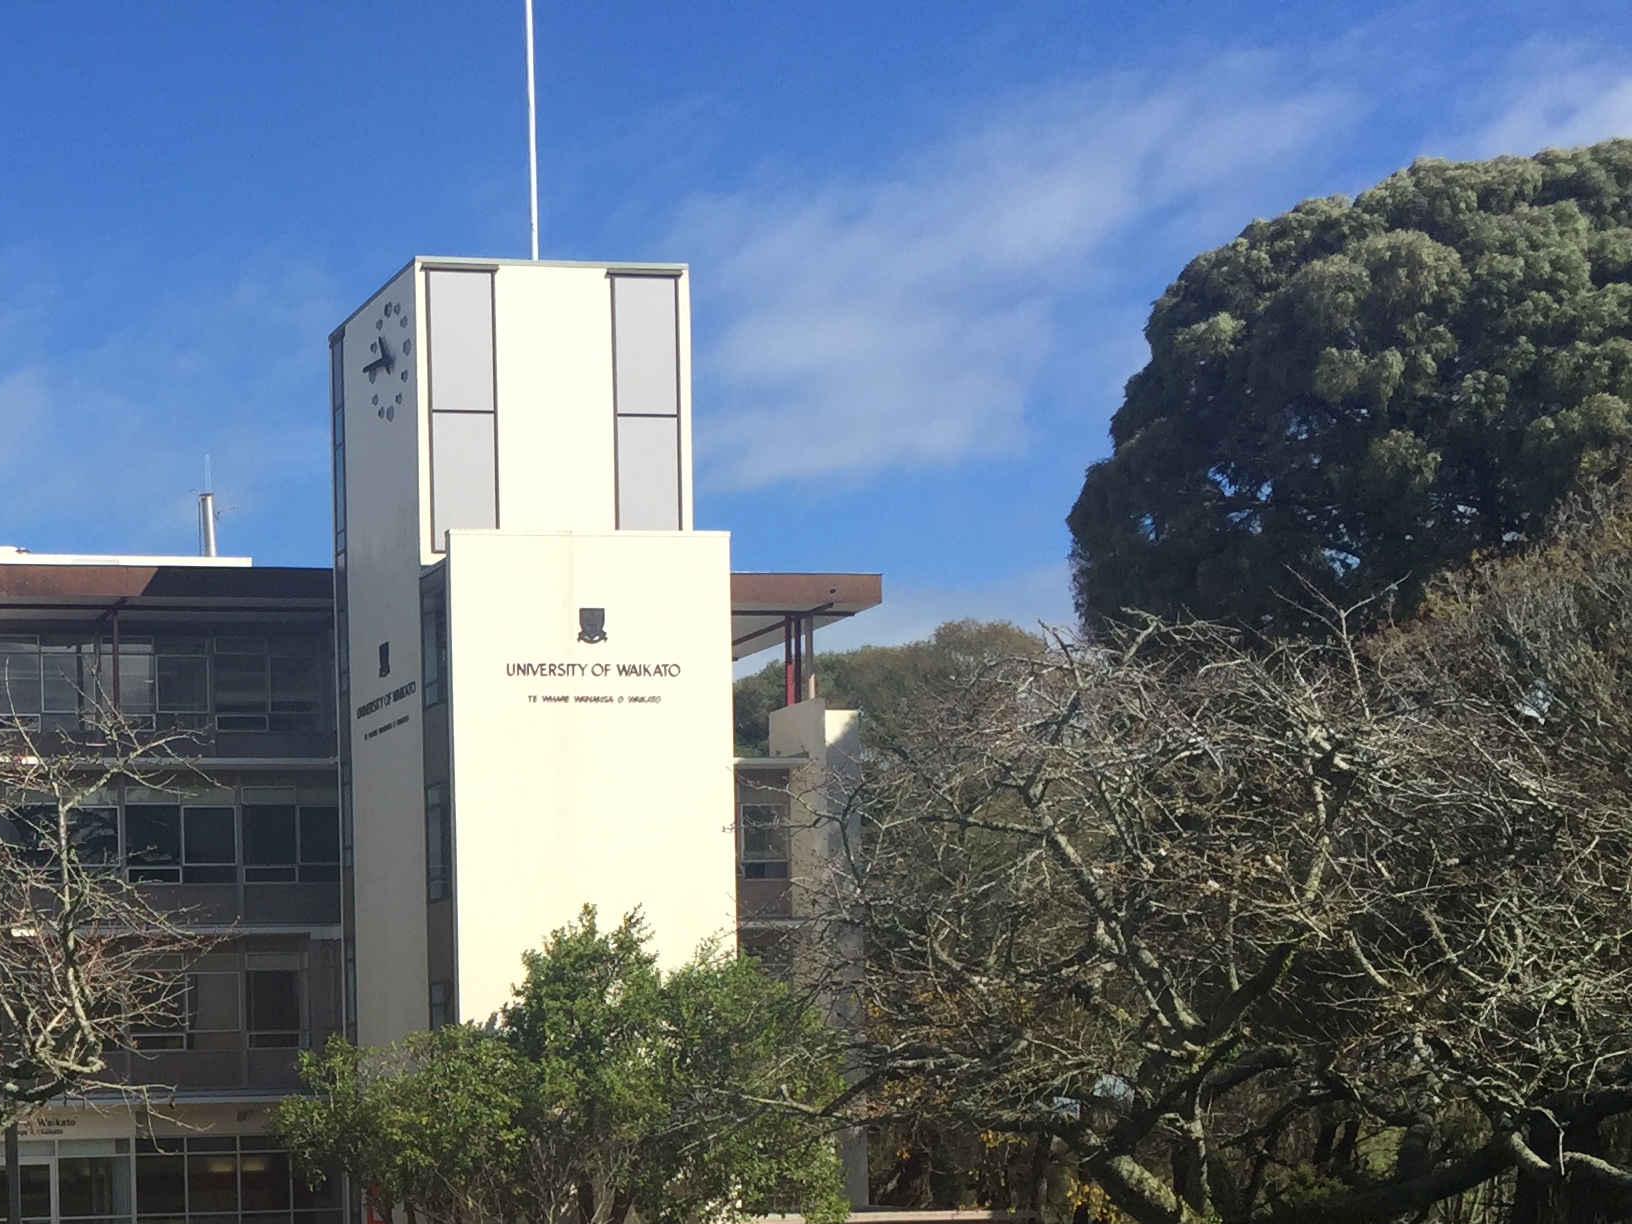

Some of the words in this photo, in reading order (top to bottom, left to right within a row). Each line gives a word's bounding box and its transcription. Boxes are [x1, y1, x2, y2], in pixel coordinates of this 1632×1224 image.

[506, 662, 588, 677] UNIVERSITY
[591, 662, 611, 677] OF
[616, 663, 682, 677] WAIKATO
